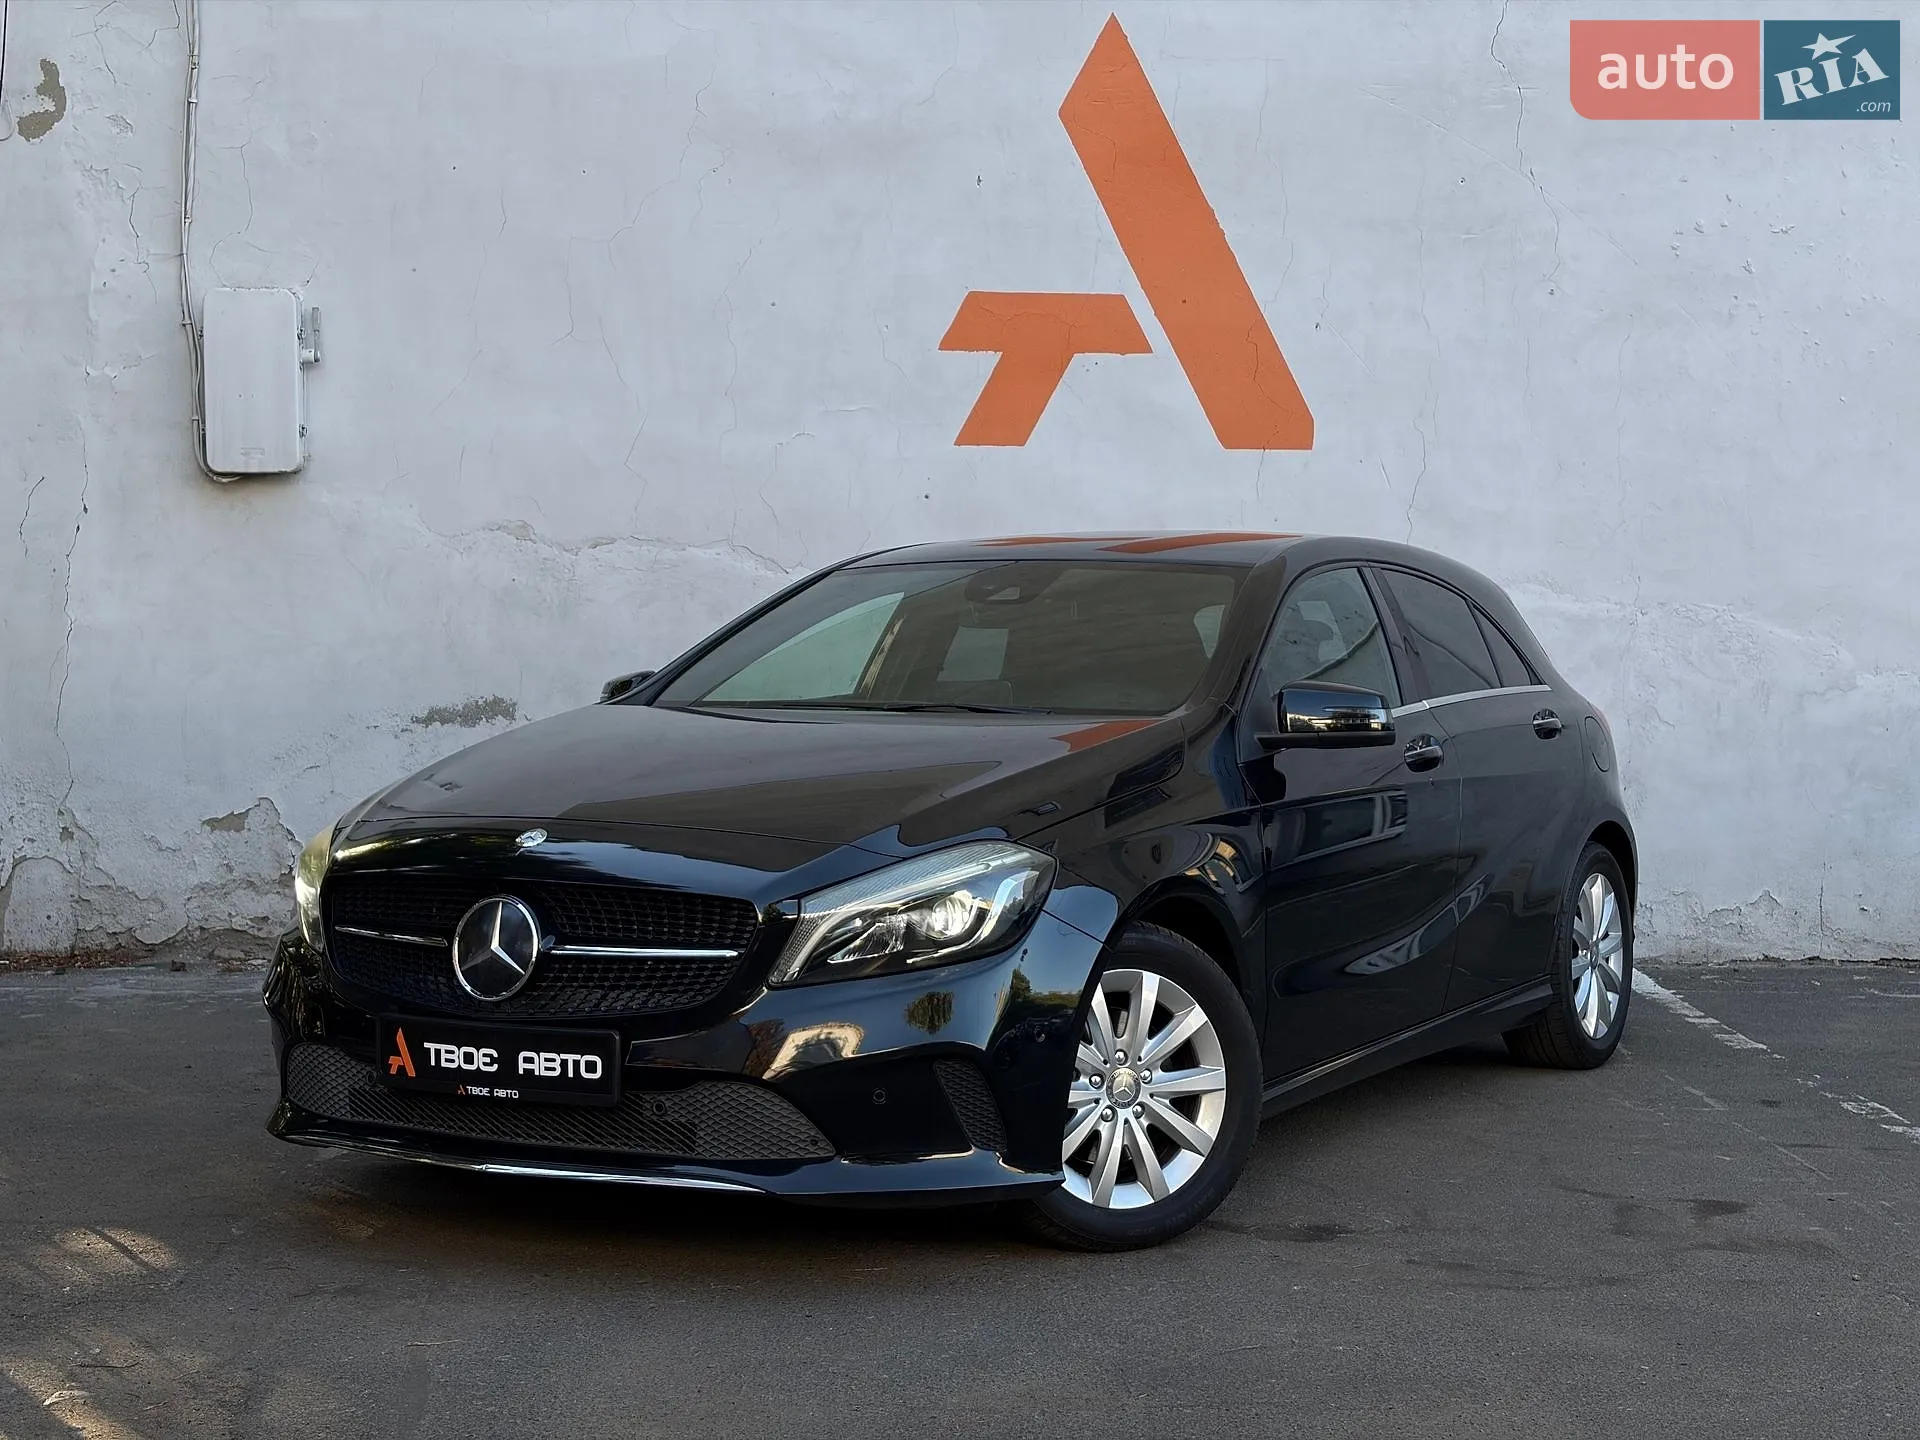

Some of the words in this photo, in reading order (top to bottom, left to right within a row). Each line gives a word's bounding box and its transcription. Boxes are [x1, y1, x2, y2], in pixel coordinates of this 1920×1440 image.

[423, 1042, 498, 1072] ТВОЄ
[518, 1051, 602, 1079] АВТО
[493, 1088, 519, 1099] АВТО
